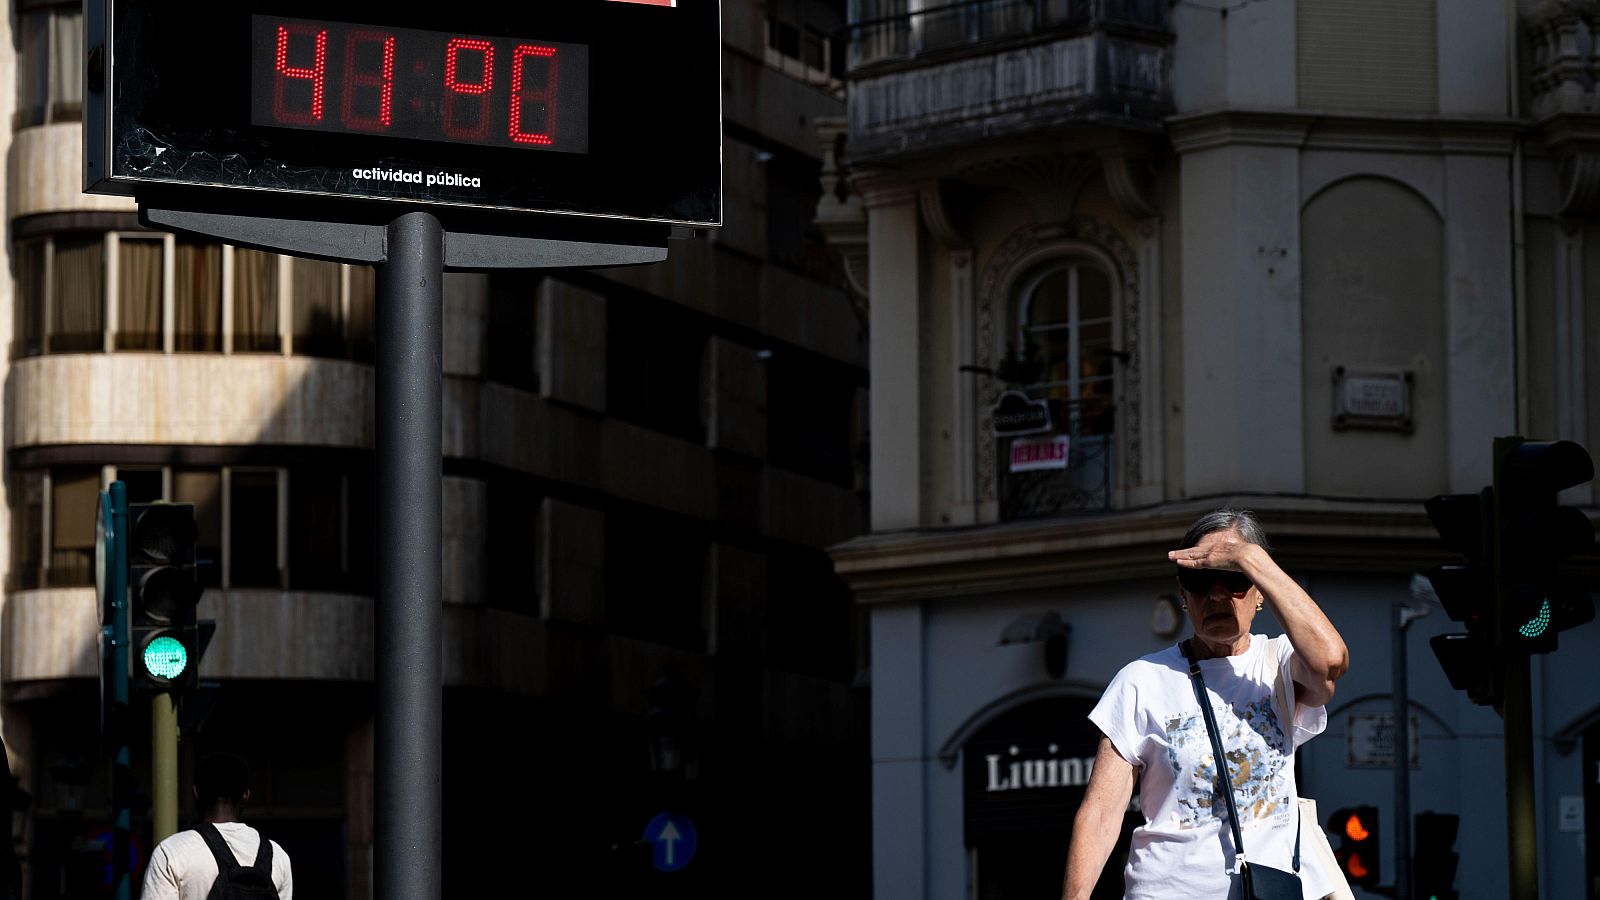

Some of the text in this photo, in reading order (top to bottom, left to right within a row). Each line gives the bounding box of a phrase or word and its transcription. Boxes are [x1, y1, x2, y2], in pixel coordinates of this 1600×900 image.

[276, 26, 395, 127] 41
[352, 167, 481, 188] actividad pública
